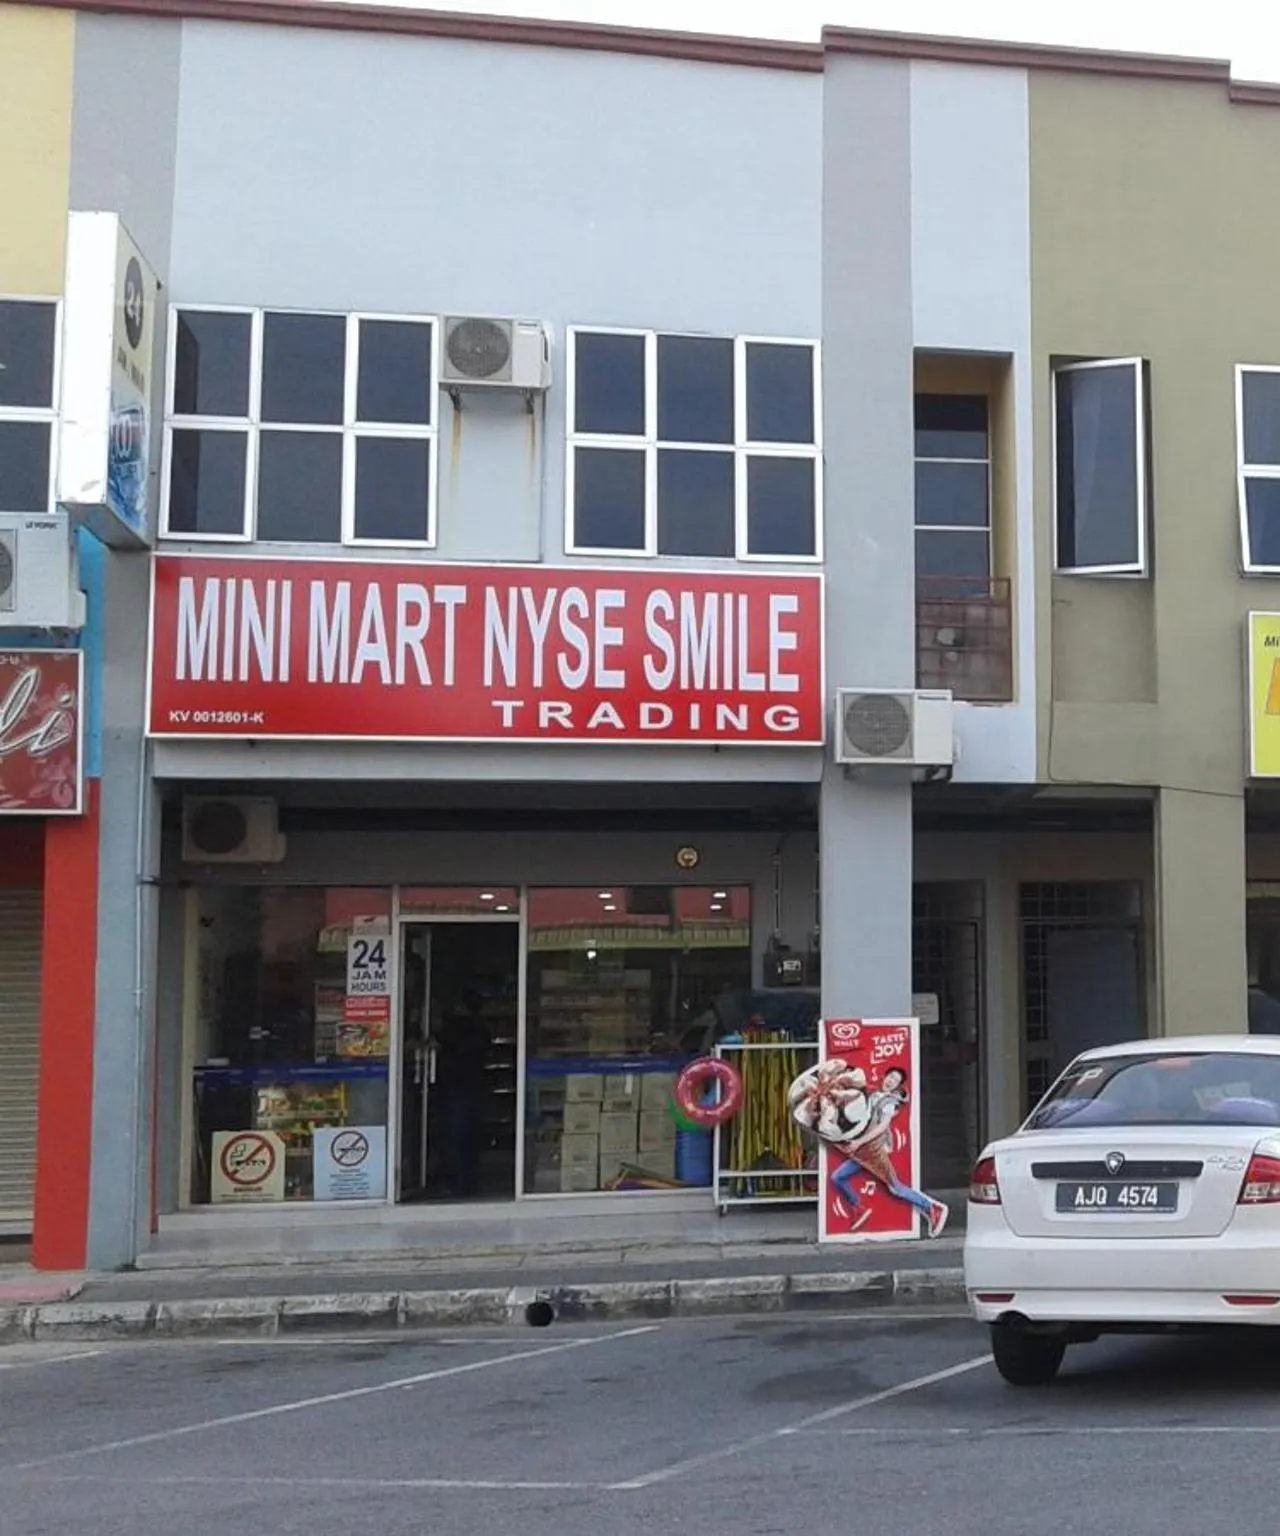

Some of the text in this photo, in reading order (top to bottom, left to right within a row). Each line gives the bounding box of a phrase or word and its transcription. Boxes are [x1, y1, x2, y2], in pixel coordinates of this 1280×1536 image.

[175, 576, 800, 692] MINI MART NYSE SMILE
[169, 710, 190, 722] KV
[491, 700, 800, 732] TRADING
[352, 939, 386, 969] 24
[351, 970, 387, 981] JAM
[350, 981, 387, 993] HOURS
[872, 1032, 905, 1045] TASTE
[874, 1043, 905, 1059] JOY
[1074, 1185, 1159, 1206] AJQ 4574
